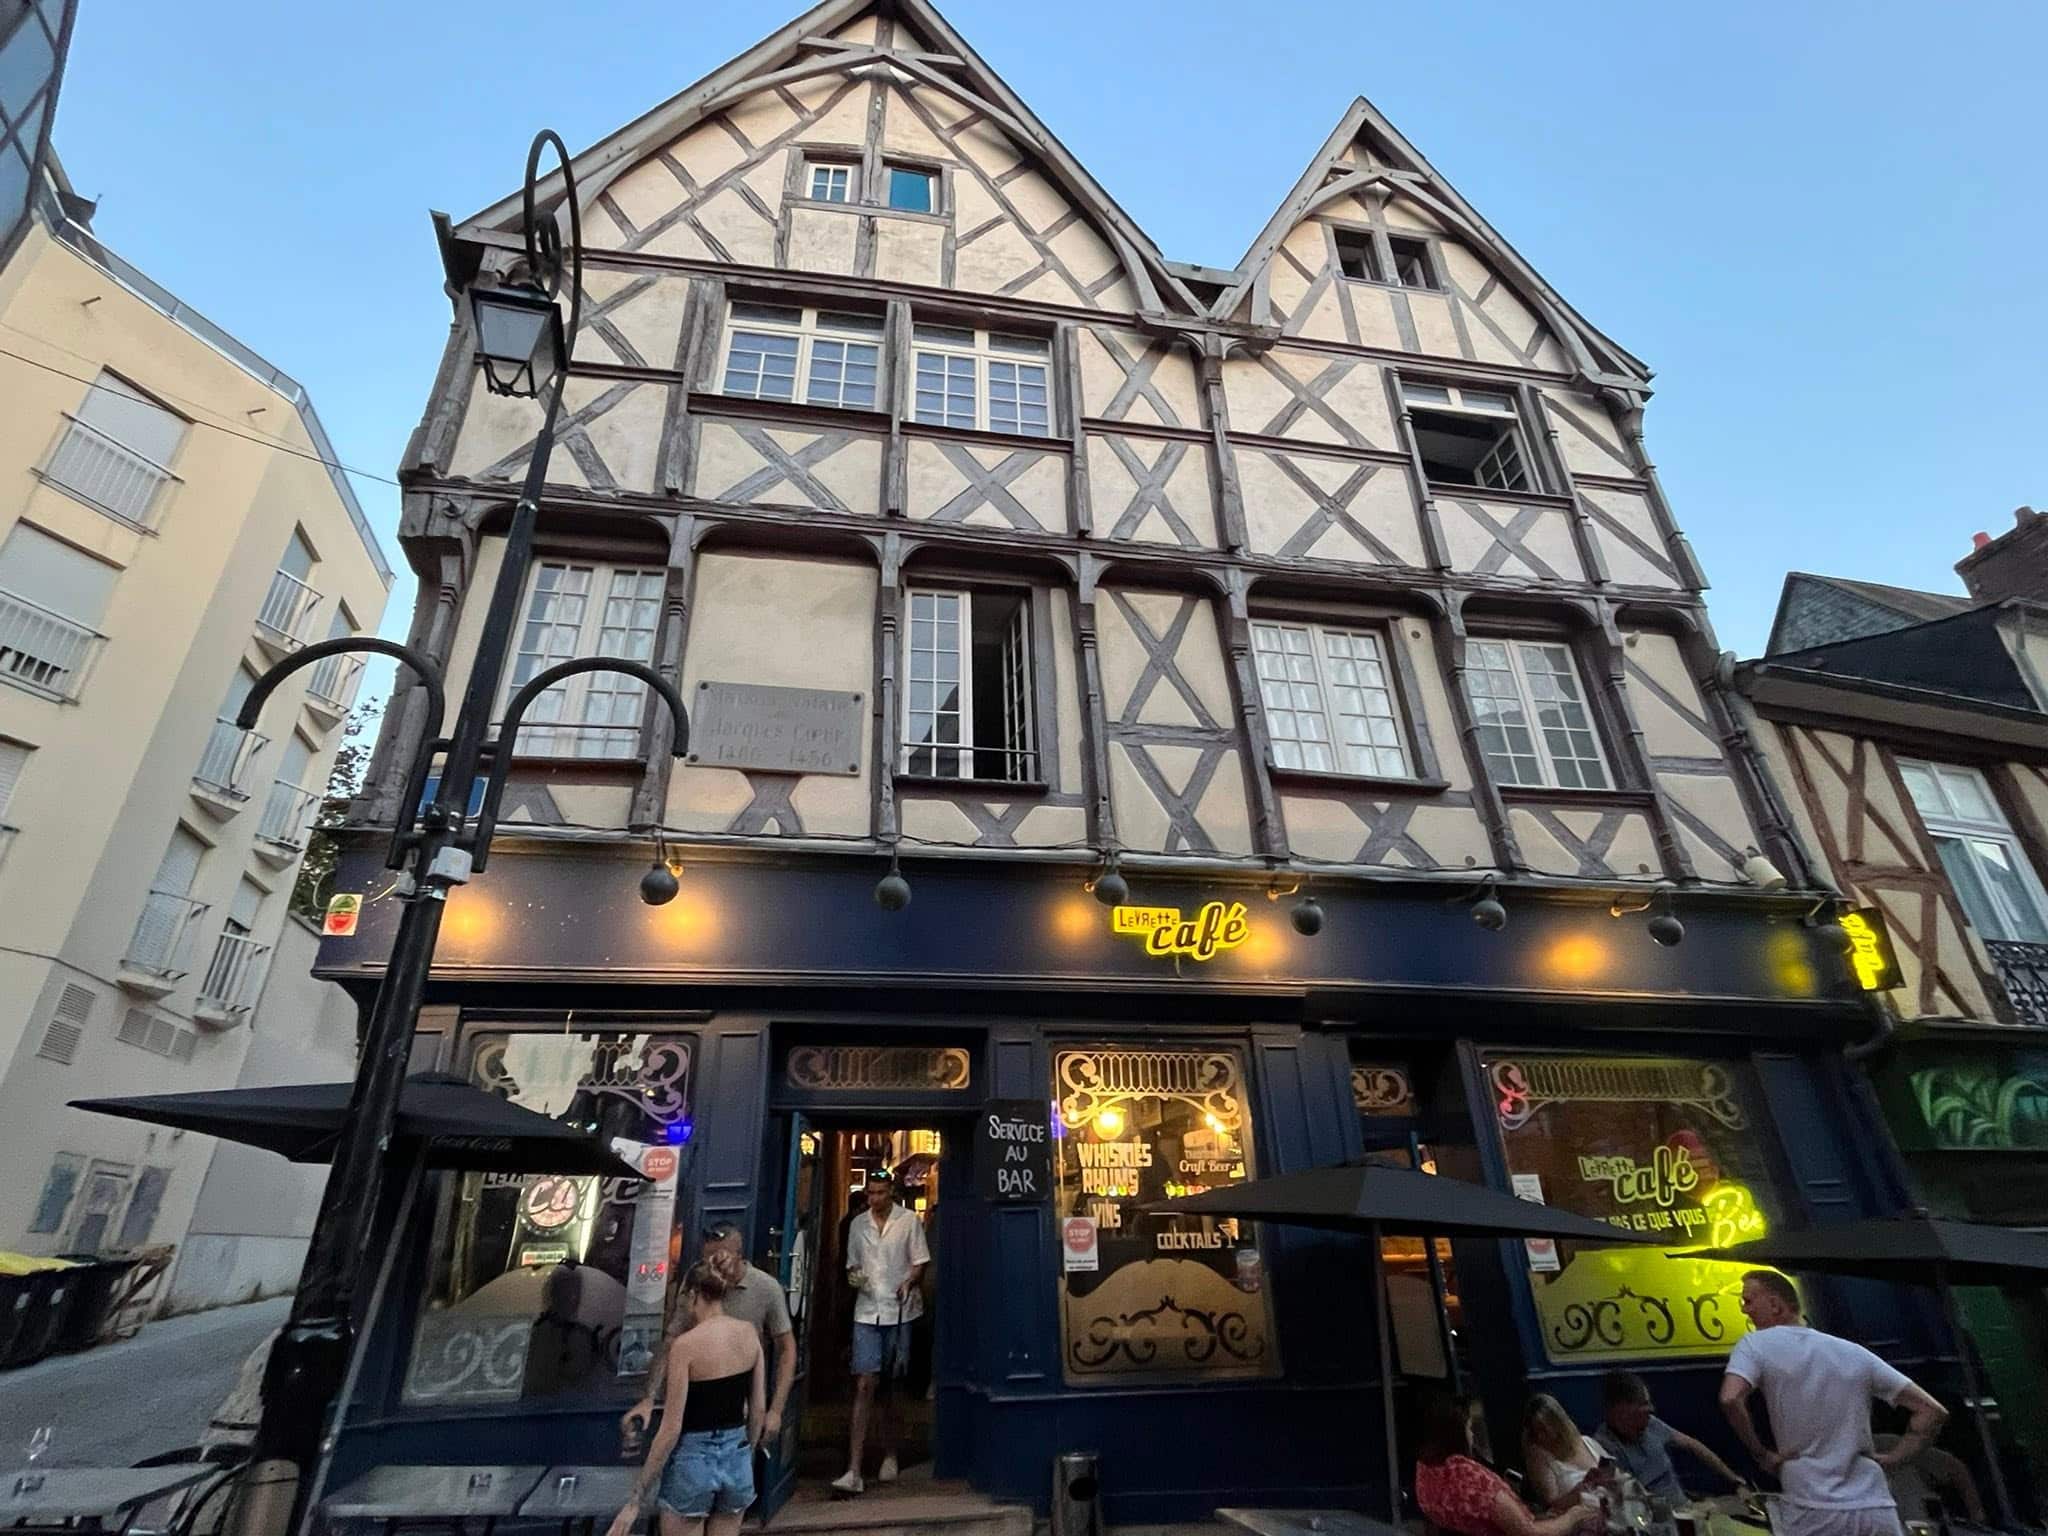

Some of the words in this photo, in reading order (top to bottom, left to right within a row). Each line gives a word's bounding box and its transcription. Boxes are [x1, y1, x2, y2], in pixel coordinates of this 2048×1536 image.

[1150, 903, 1248, 957] café
[988, 1114, 1045, 1143] SERVICE
[647, 1157, 673, 1167] STOP
[1005, 1144, 1028, 1162] AU
[997, 1168, 1037, 1193] BAR
[1615, 1146, 1698, 1206] café
[1632, 1213, 1648, 1232] CE
[1647, 1210, 1674, 1232] QUE
[1156, 1226, 1222, 1249] COCKTAILS
